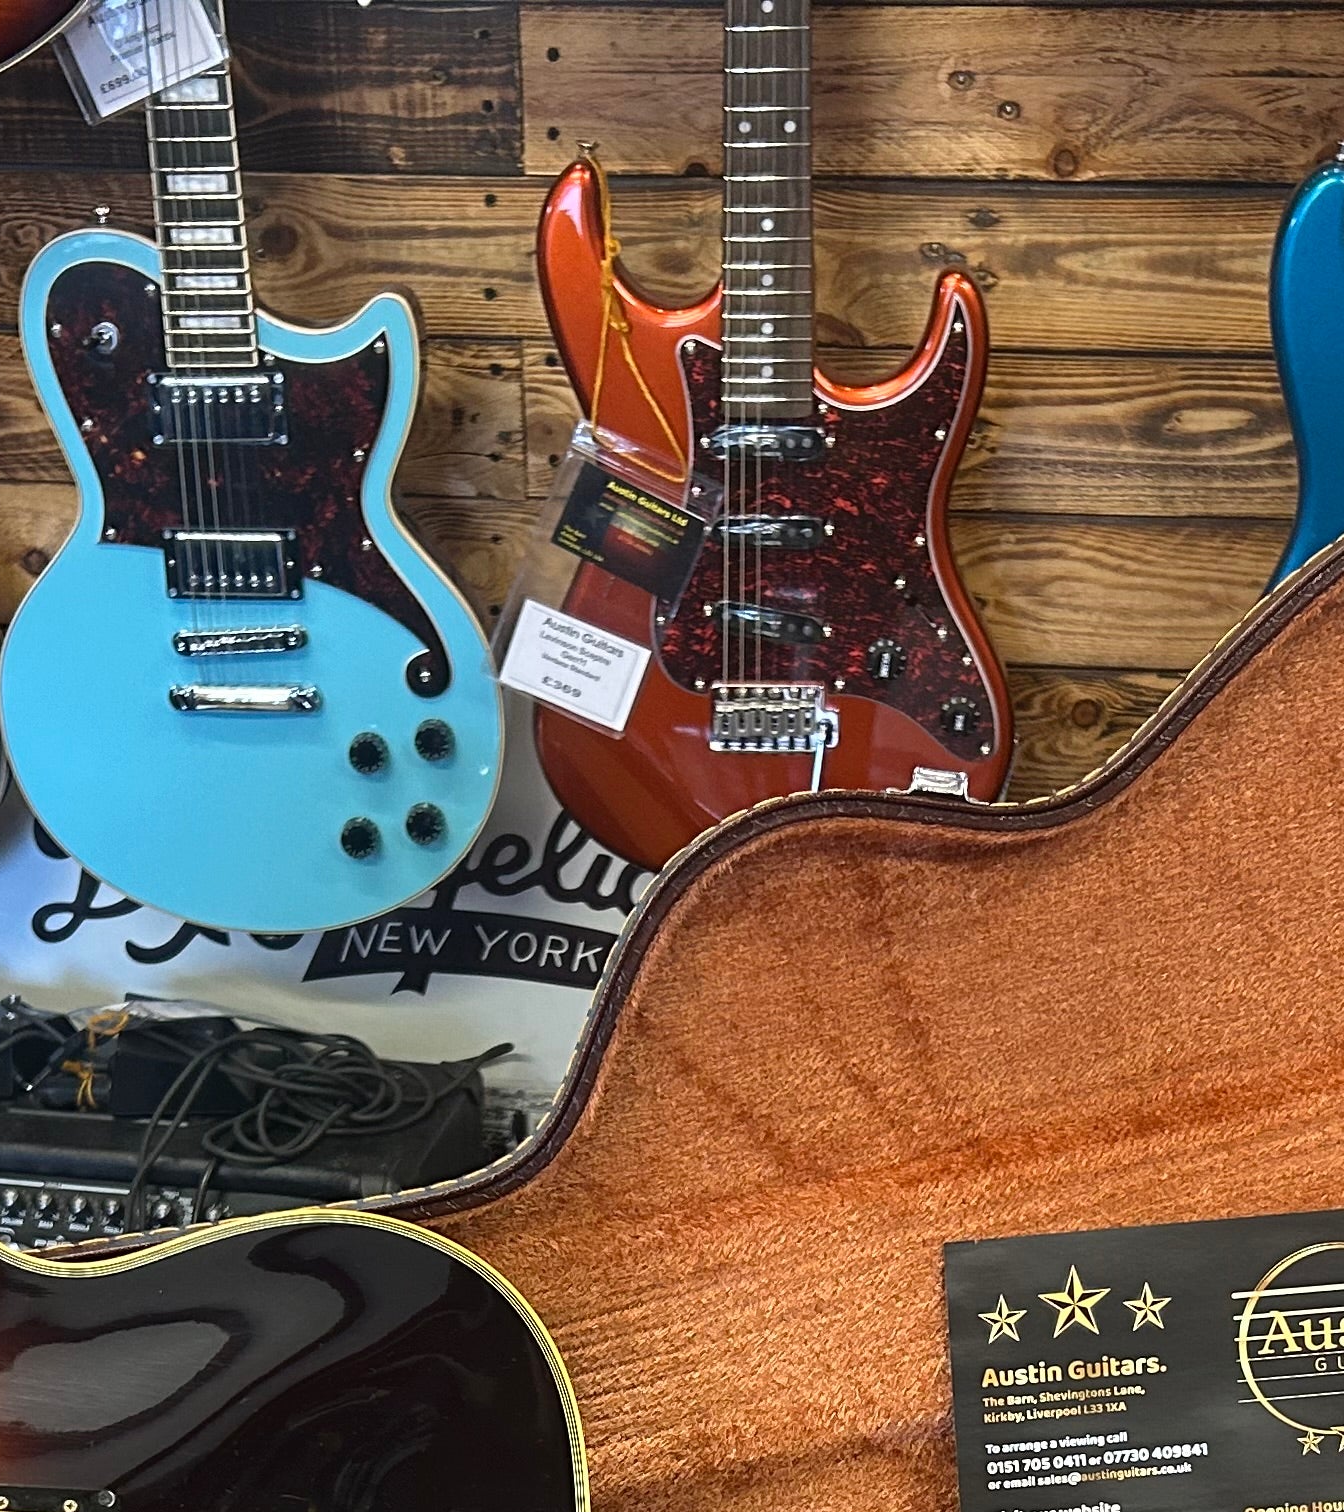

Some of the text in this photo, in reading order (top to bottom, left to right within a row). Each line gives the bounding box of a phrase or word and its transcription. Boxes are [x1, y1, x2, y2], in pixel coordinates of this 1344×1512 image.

[542, 617, 624, 658] Austin Guitars
[340, 920, 605, 974] NEW YORK
[982, 1355, 1168, 1388] Austin Guitars.
[982, 1385, 1146, 1408] The Barn, Shevingtons Lane,
[984, 1401, 1127, 1424] Kirkby, Liverpool L33 1XA
[985, 1431, 1128, 1454] To arrange a viewing call
[987, 1442, 1209, 1475] 0151 705 0411 or 07730 409841
[987, 1462, 1192, 1490] or email sales@austinguitars.co.uk
